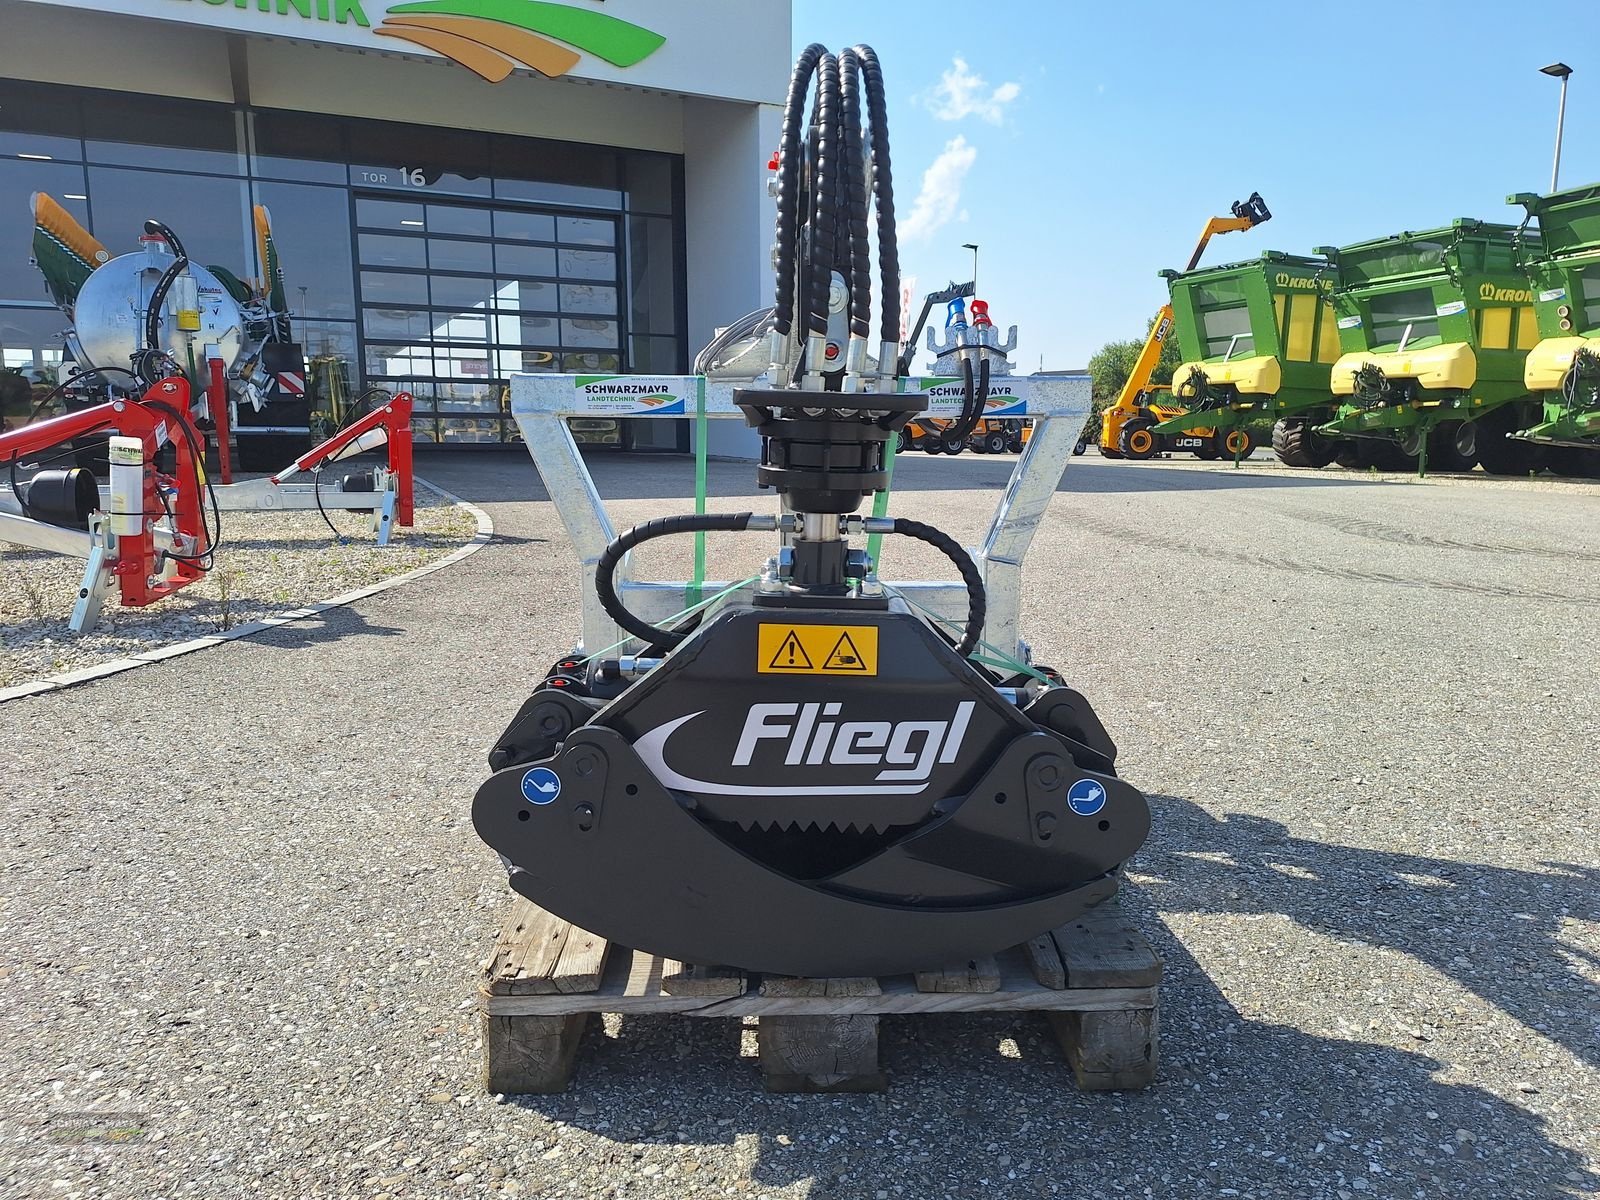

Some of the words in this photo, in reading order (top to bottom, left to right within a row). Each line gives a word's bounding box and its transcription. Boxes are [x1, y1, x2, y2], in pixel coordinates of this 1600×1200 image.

[361, 172, 387, 183] TOR
[400, 166, 426, 186] 16
[1156, 318, 1169, 342] JCB
[585, 385, 669, 394] SCHWARZMAYR
[929, 386, 1012, 396] SCHWAZAYR
[1176, 438, 1203, 447] JCB
[731, 701, 976, 780] Fliegl
